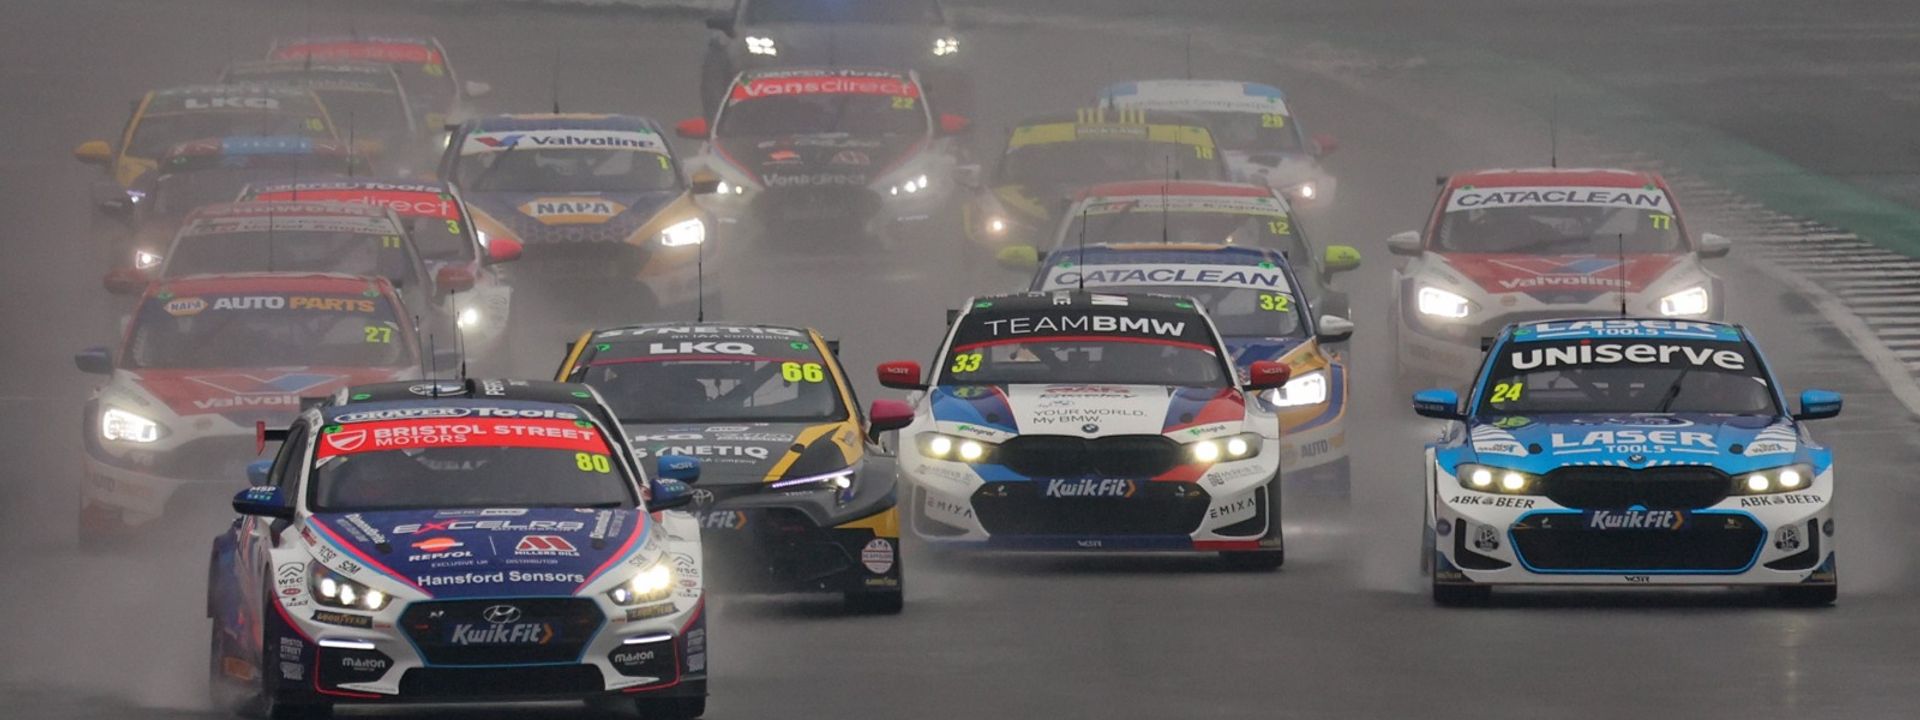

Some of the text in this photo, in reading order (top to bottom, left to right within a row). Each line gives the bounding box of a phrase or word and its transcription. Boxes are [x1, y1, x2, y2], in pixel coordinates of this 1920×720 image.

[744, 79, 912, 96] Vansdirect
[185, 98, 279, 110] LKQ
[530, 135, 655, 148] Valvoline
[362, 182, 442, 193] Tools
[1456, 190, 1662, 207] CATACLEAN
[536, 203, 611, 215] NAPA
[445, 219, 459, 235] 3
[1268, 221, 1291, 235] 12
[1649, 214, 1672, 230] 77
[382, 235, 400, 248] 11
[1054, 268, 1281, 288] CATACLEAN
[1498, 275, 1631, 289] Valvoline
[213, 296, 285, 311] AUTO
[289, 297, 376, 313] PARTS
[1259, 294, 1289, 312] 32
[1535, 319, 1716, 333] LASER
[1596, 328, 1659, 336] TOOLS
[364, 326, 392, 344] 27
[649, 341, 757, 356] LKQ
[951, 353, 984, 374] 33
[781, 361, 824, 383] 66
[1490, 382, 1523, 403] 24
[193, 394, 301, 409] Valvoli
[470, 407, 579, 420] Tools
[1034, 408, 1080, 417] YOUR
[1032, 417, 1055, 425] My
[374, 424, 594, 441] BRISTOL STREET
[634, 433, 704, 442] KQ
[1551, 429, 1718, 448] LASER
[375, 434, 467, 447] MOTORS
[1302, 439, 1329, 458] AUTO
[1606, 445, 1666, 455] TOOLS
[575, 452, 610, 474] 80
[1449, 495, 1536, 509] ABK BEER
[1741, 494, 1825, 508] ABK BEER
[408, 551, 473, 562] REPSOL
[558, 550, 581, 558] OILS
[417, 570, 585, 587] Hansford Sensors
